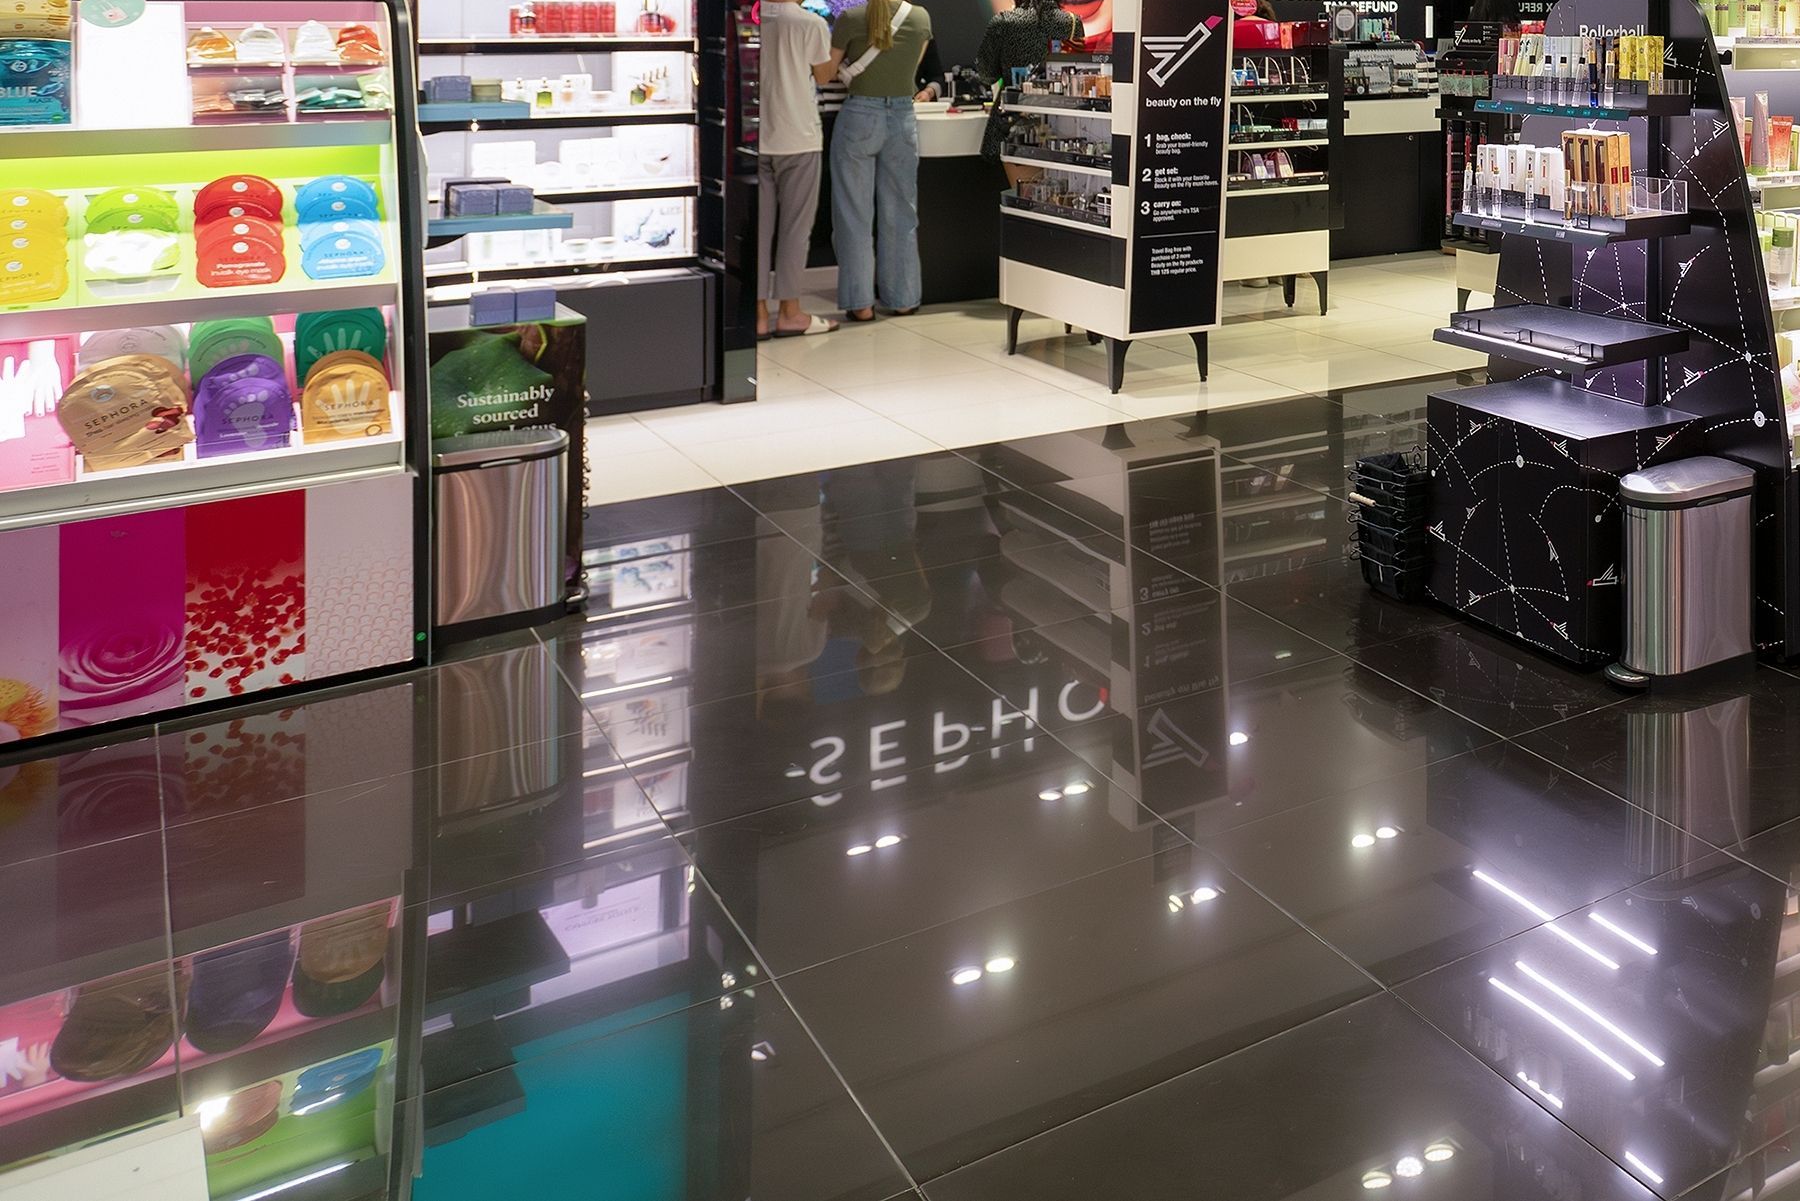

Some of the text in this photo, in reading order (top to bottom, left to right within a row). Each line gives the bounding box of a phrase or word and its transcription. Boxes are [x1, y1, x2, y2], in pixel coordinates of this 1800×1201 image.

[1145, 95, 1222, 109] beauty on the fly
[1144, 133, 1151, 148] 1
[1142, 167, 1152, 182] 2
[1154, 167, 1165, 177] get
[1140, 200, 1151, 215] 3
[1153, 201, 1171, 209] carry
[457, 384, 556, 409] Sustainably
[324, 400, 375, 411] SEPHORA
[84, 398, 149, 430] SEPHORA
[222, 413, 274, 425] SEPHORA
[472, 403, 539, 426] sourced
